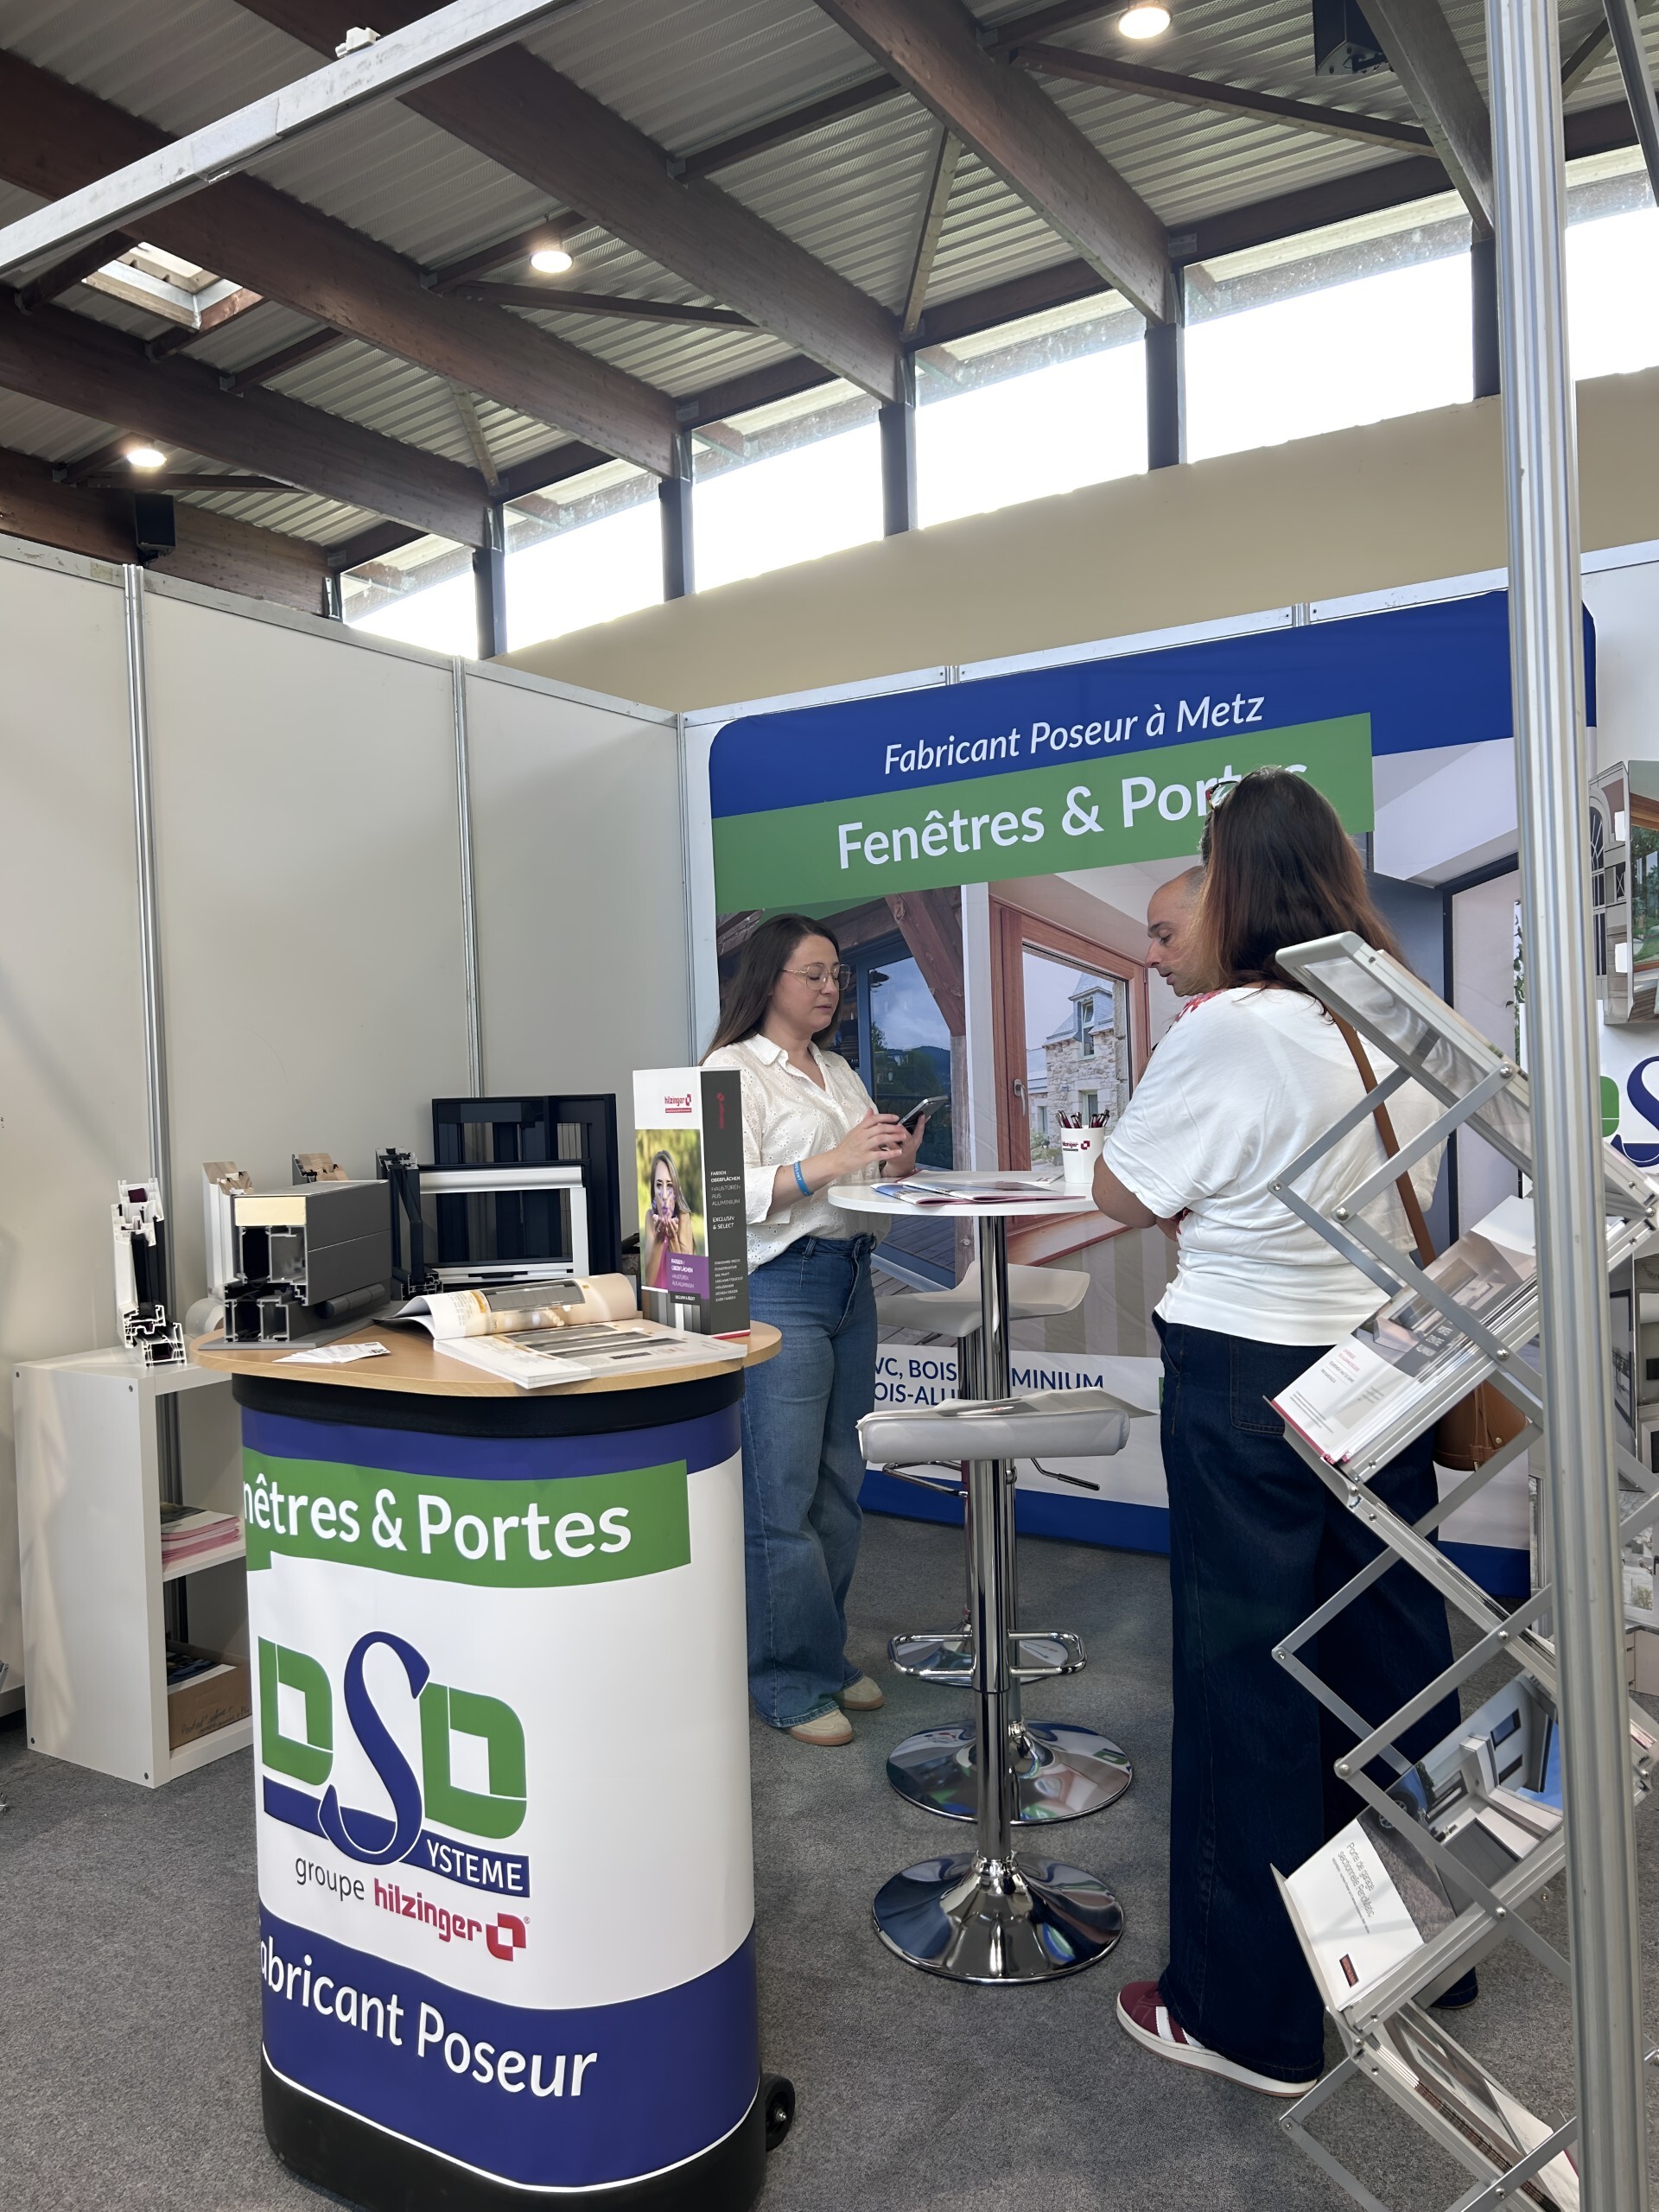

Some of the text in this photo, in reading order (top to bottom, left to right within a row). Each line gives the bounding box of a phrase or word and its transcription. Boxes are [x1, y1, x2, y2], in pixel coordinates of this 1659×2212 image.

[884, 693, 1266, 775] Fabricant Poseur à Metz
[837, 806, 1046, 870] Fenêtres
[1061, 785, 1105, 836] &
[908, 1358, 957, 1382] BOIS
[1011, 1367, 1103, 1389] MINIUM
[243, 1472, 632, 1561] nêtres & Portes
[295, 1857, 482, 1943] groupe hilzinger
[259, 1934, 598, 2098] abricant Poseur
